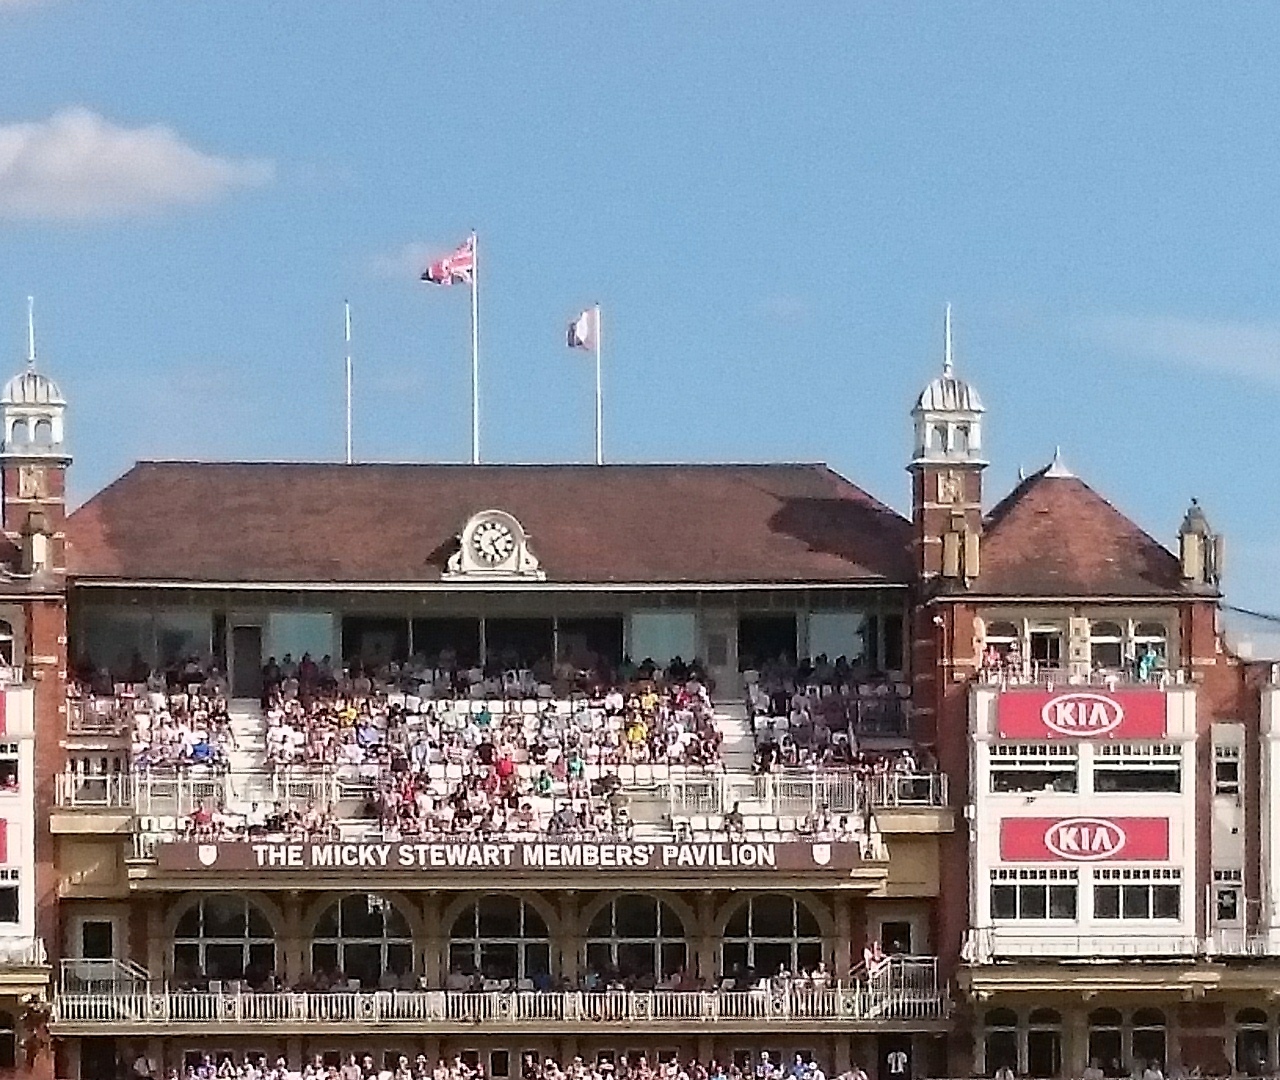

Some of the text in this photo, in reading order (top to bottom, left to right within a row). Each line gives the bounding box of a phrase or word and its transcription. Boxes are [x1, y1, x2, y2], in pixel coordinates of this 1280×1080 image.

[1056, 702, 1110, 726] KIA
[1058, 826, 1114, 851] KIA
[252, 845, 776, 866] THE MICKY STEWART MEMBERS' PAVILION
